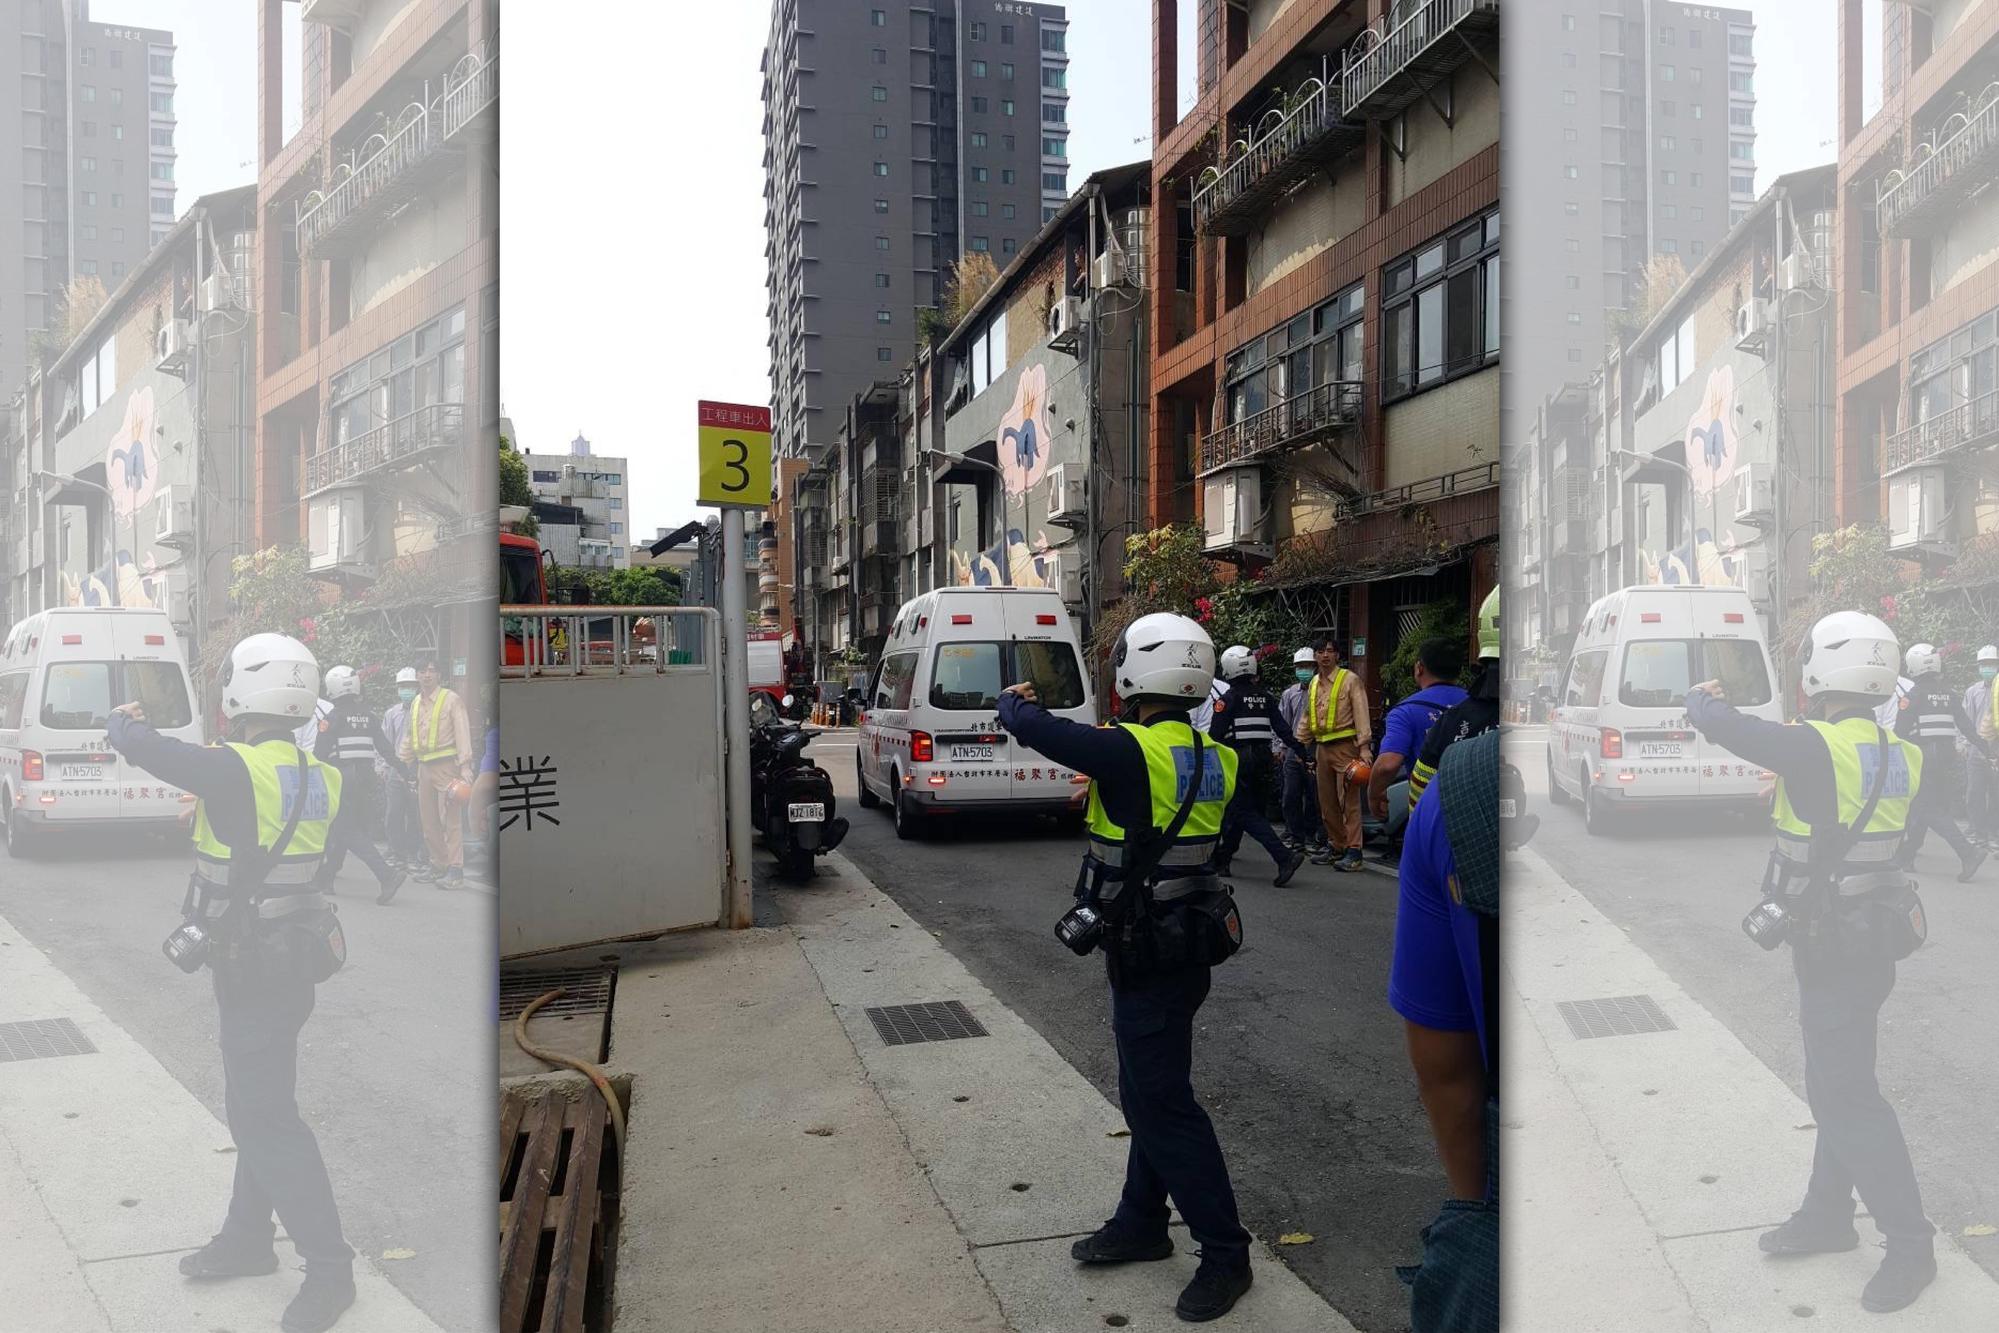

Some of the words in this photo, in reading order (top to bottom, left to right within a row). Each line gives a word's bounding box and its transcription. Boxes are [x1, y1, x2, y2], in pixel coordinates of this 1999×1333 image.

[701, 407, 768, 427] 工程車出入
[721, 439, 750, 492] 3
[500, 755, 560, 831] 業
[1180, 773, 1224, 797] PLICE
